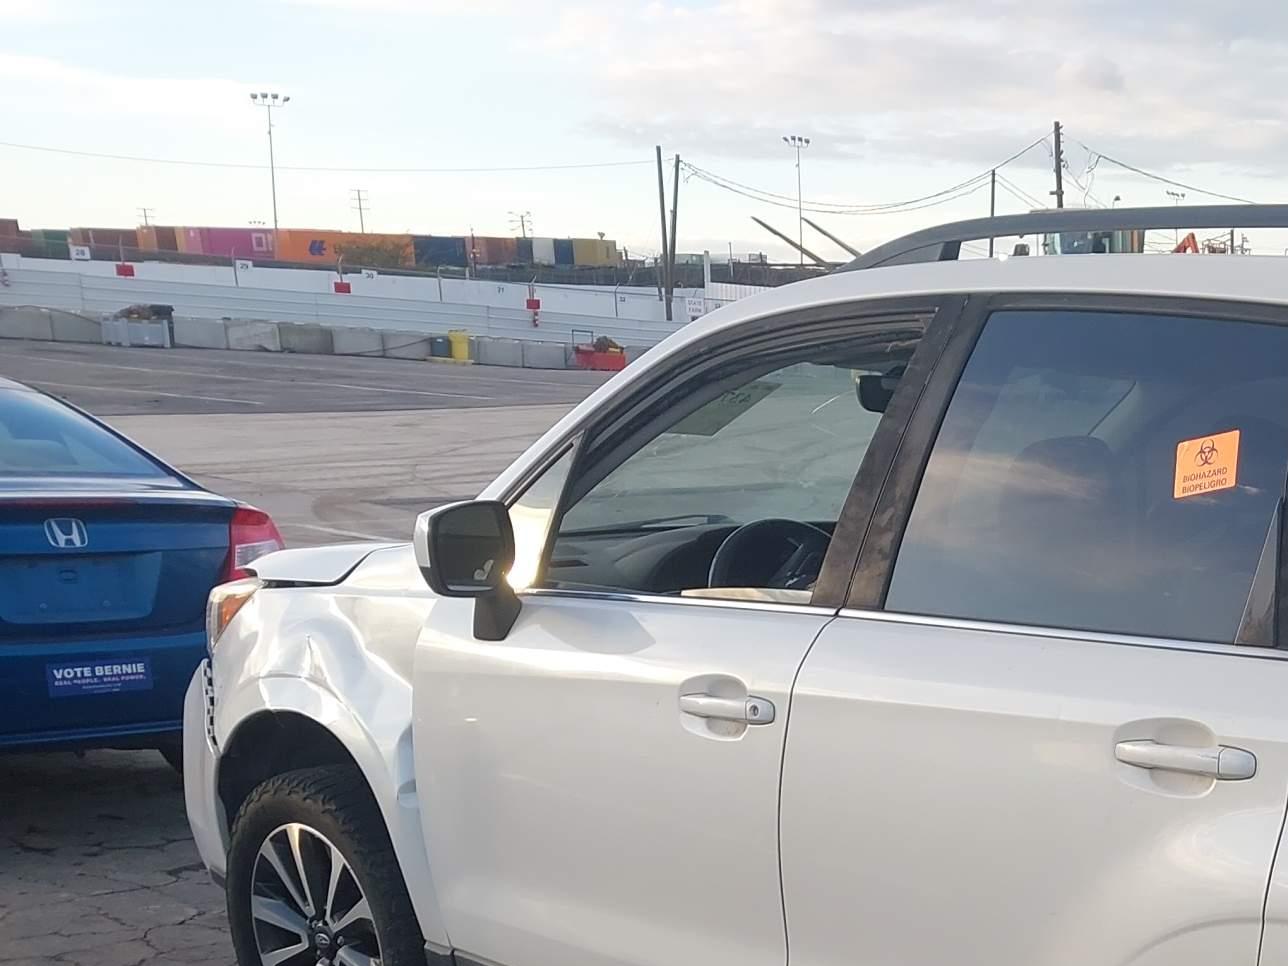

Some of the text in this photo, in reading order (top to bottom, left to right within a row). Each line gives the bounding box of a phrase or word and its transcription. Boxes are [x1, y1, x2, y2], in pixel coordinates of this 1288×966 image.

[1183, 466, 1228, 483] BIOHAZARD
[1182, 477, 1227, 494] BIOPELIGRO
[53, 663, 145, 679] VOTE BERNIE
